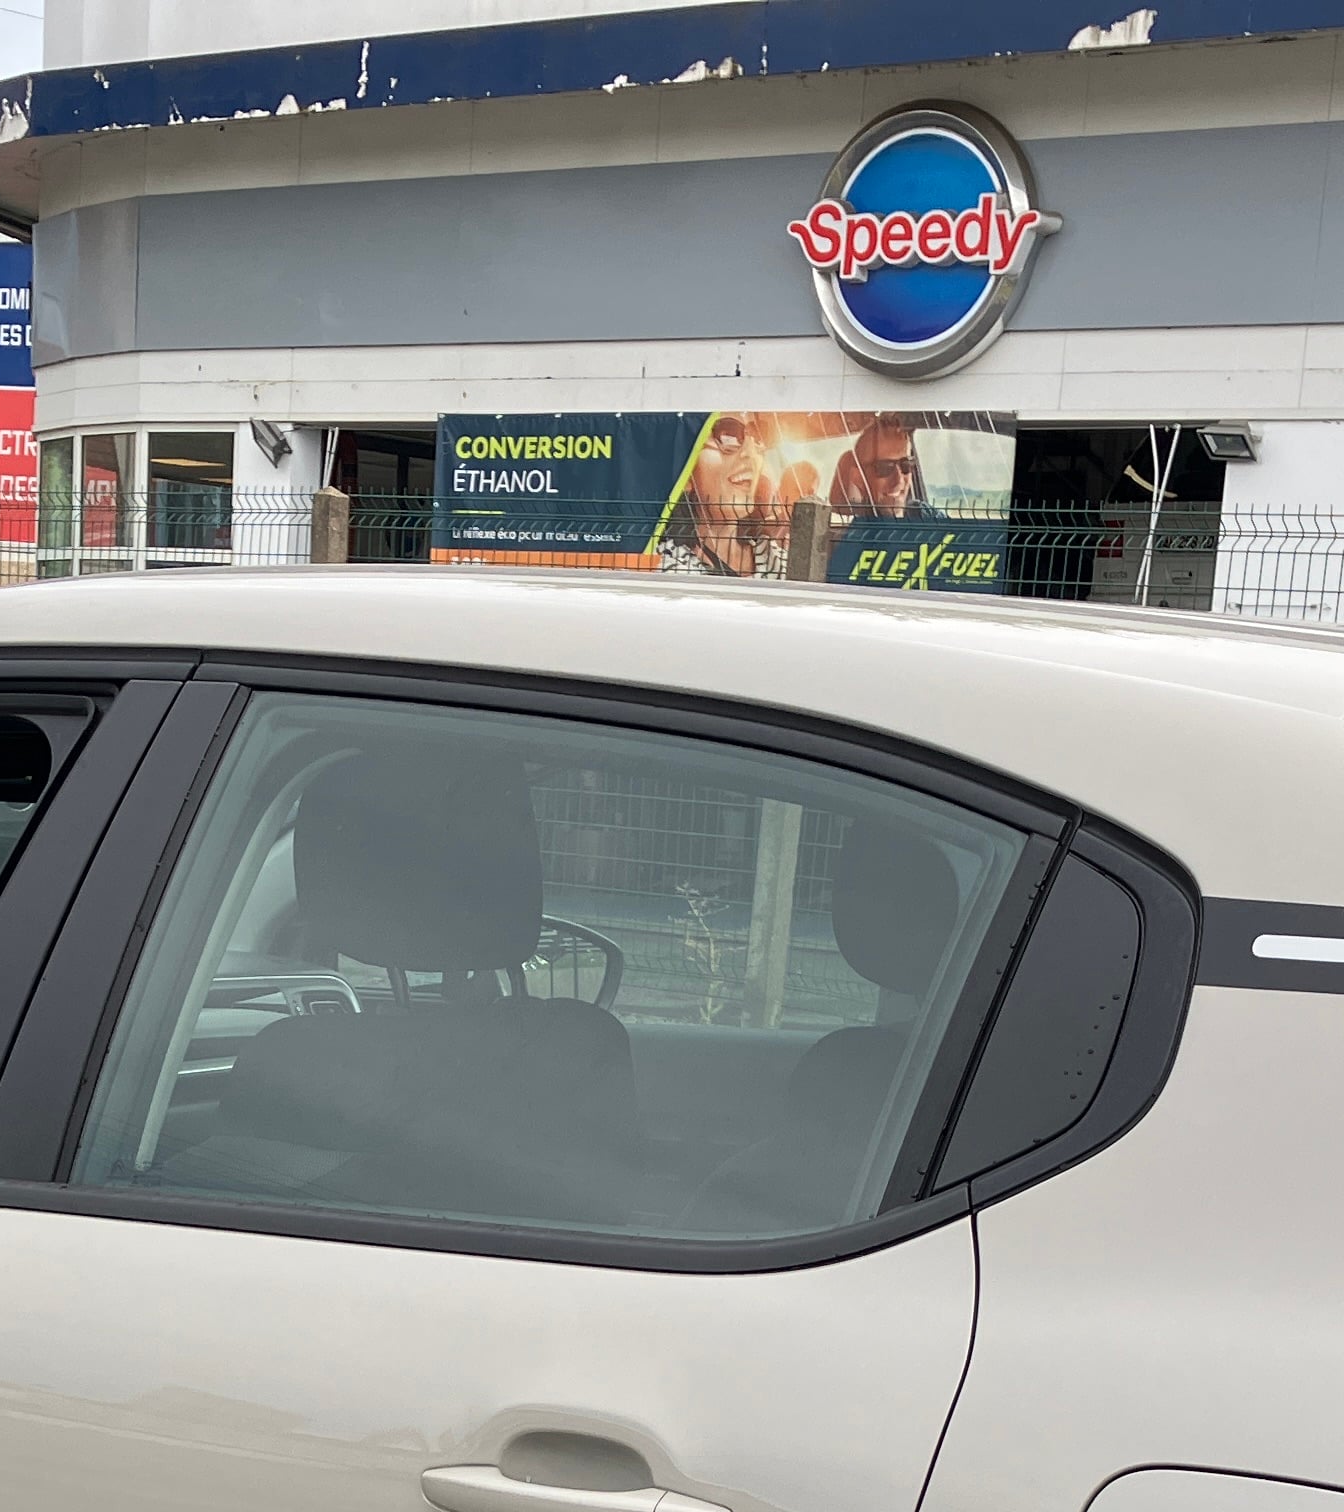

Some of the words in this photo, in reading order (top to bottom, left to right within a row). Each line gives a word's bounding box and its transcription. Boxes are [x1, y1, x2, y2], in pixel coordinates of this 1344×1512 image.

[787, 193, 1040, 278] Speedy
[456, 435, 612, 460] CONVERSION
[453, 463, 559, 493] ÉTHANOL
